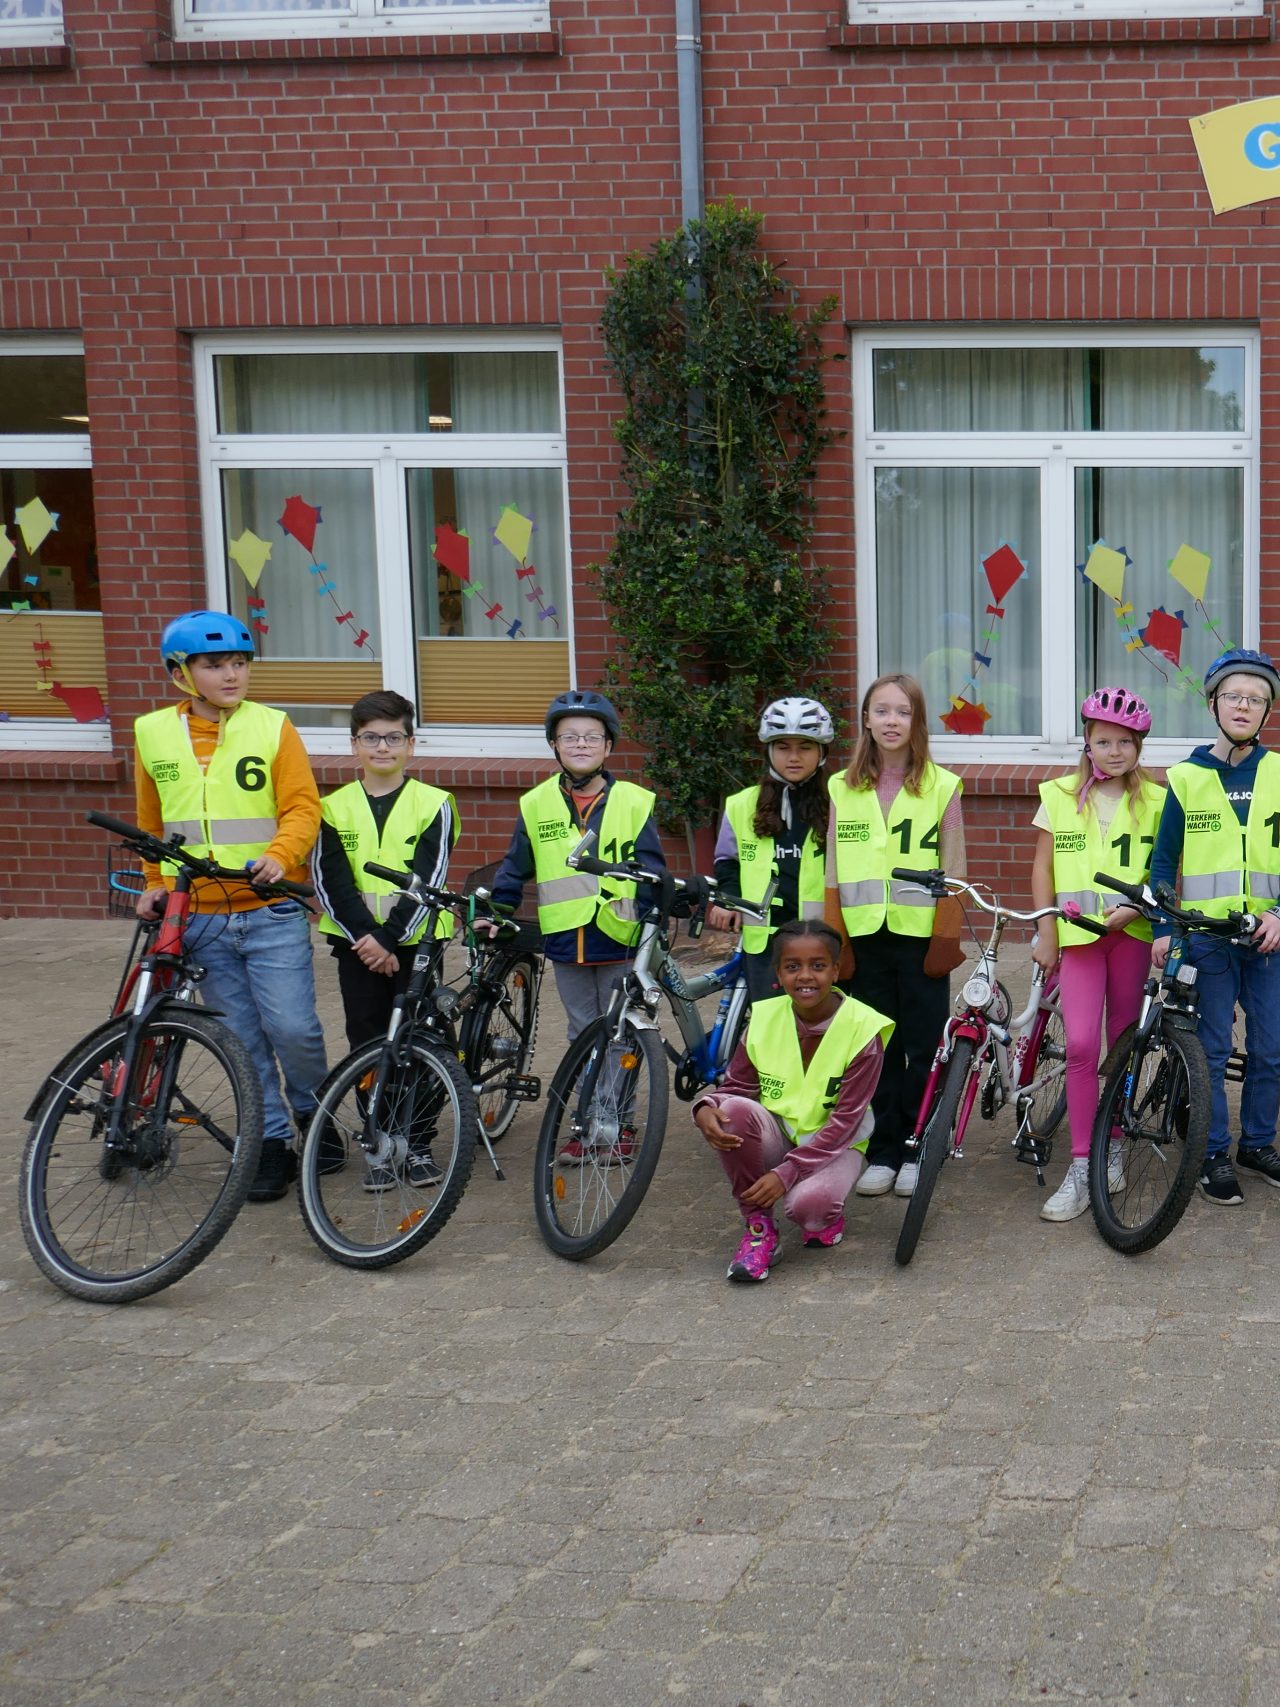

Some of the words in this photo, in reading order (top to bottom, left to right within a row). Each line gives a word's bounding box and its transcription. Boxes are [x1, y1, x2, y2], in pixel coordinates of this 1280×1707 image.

[235, 756, 266, 792] 6
[1186, 813, 1221, 822] VERKEHRS
[538, 821, 565, 832] VERKEHR
[838, 823, 870, 831] VERKEHRS
[1186, 822, 1210, 830] WACHT
[1264, 811, 1280, 848] 1
[838, 831, 860, 839] WACHT
[891, 818, 939, 856] 14
